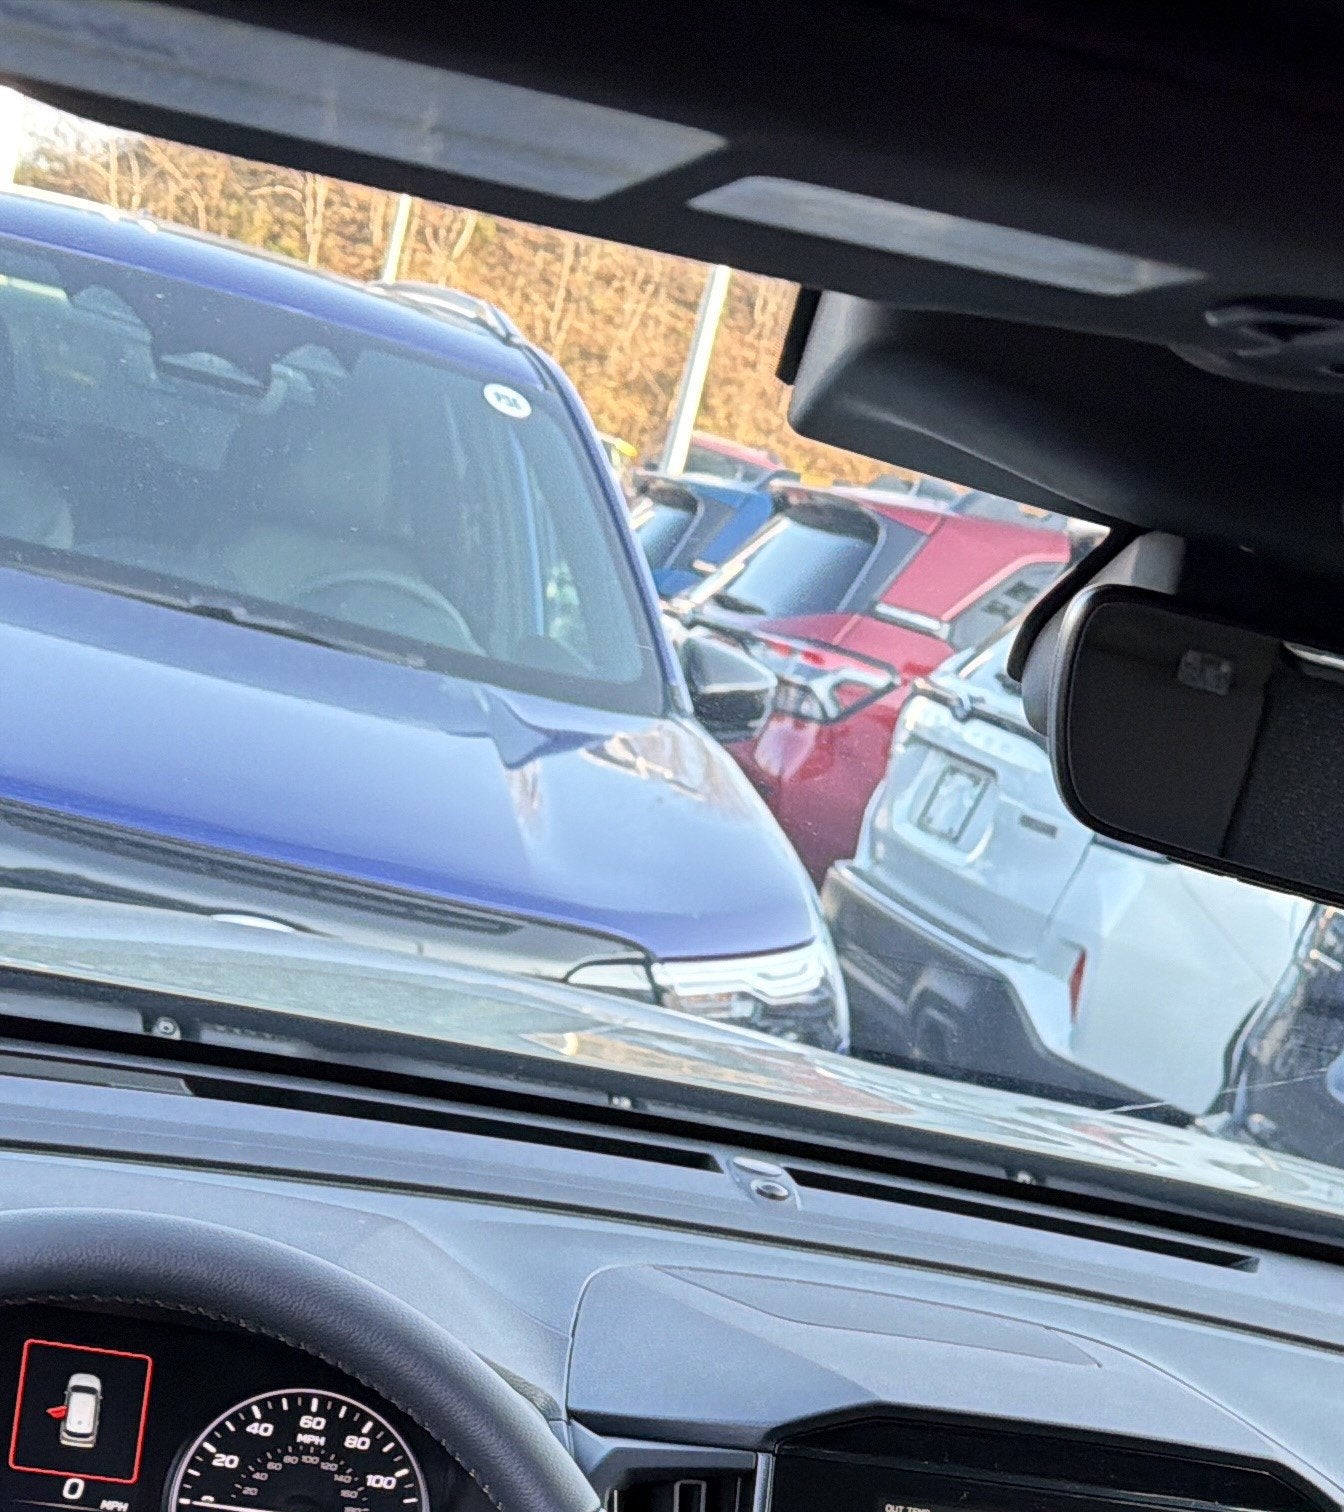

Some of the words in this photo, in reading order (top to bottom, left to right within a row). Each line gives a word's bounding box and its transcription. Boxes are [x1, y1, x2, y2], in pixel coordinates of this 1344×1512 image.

[245, 1422, 274, 1437] 40
[299, 1415, 326, 1430] 60
[296, 1433, 326, 1447] MPH
[343, 1435, 371, 1450] 80
[212, 1453, 239, 1468] 20
[301, 1454, 320, 1465] 100
[252, 1471, 269, 1481] 40
[366, 1474, 396, 1489] 100
[62, 1477, 85, 1500] 0
[242, 1486, 258, 1496] 20
[99, 1499, 129, 1512] MPH
